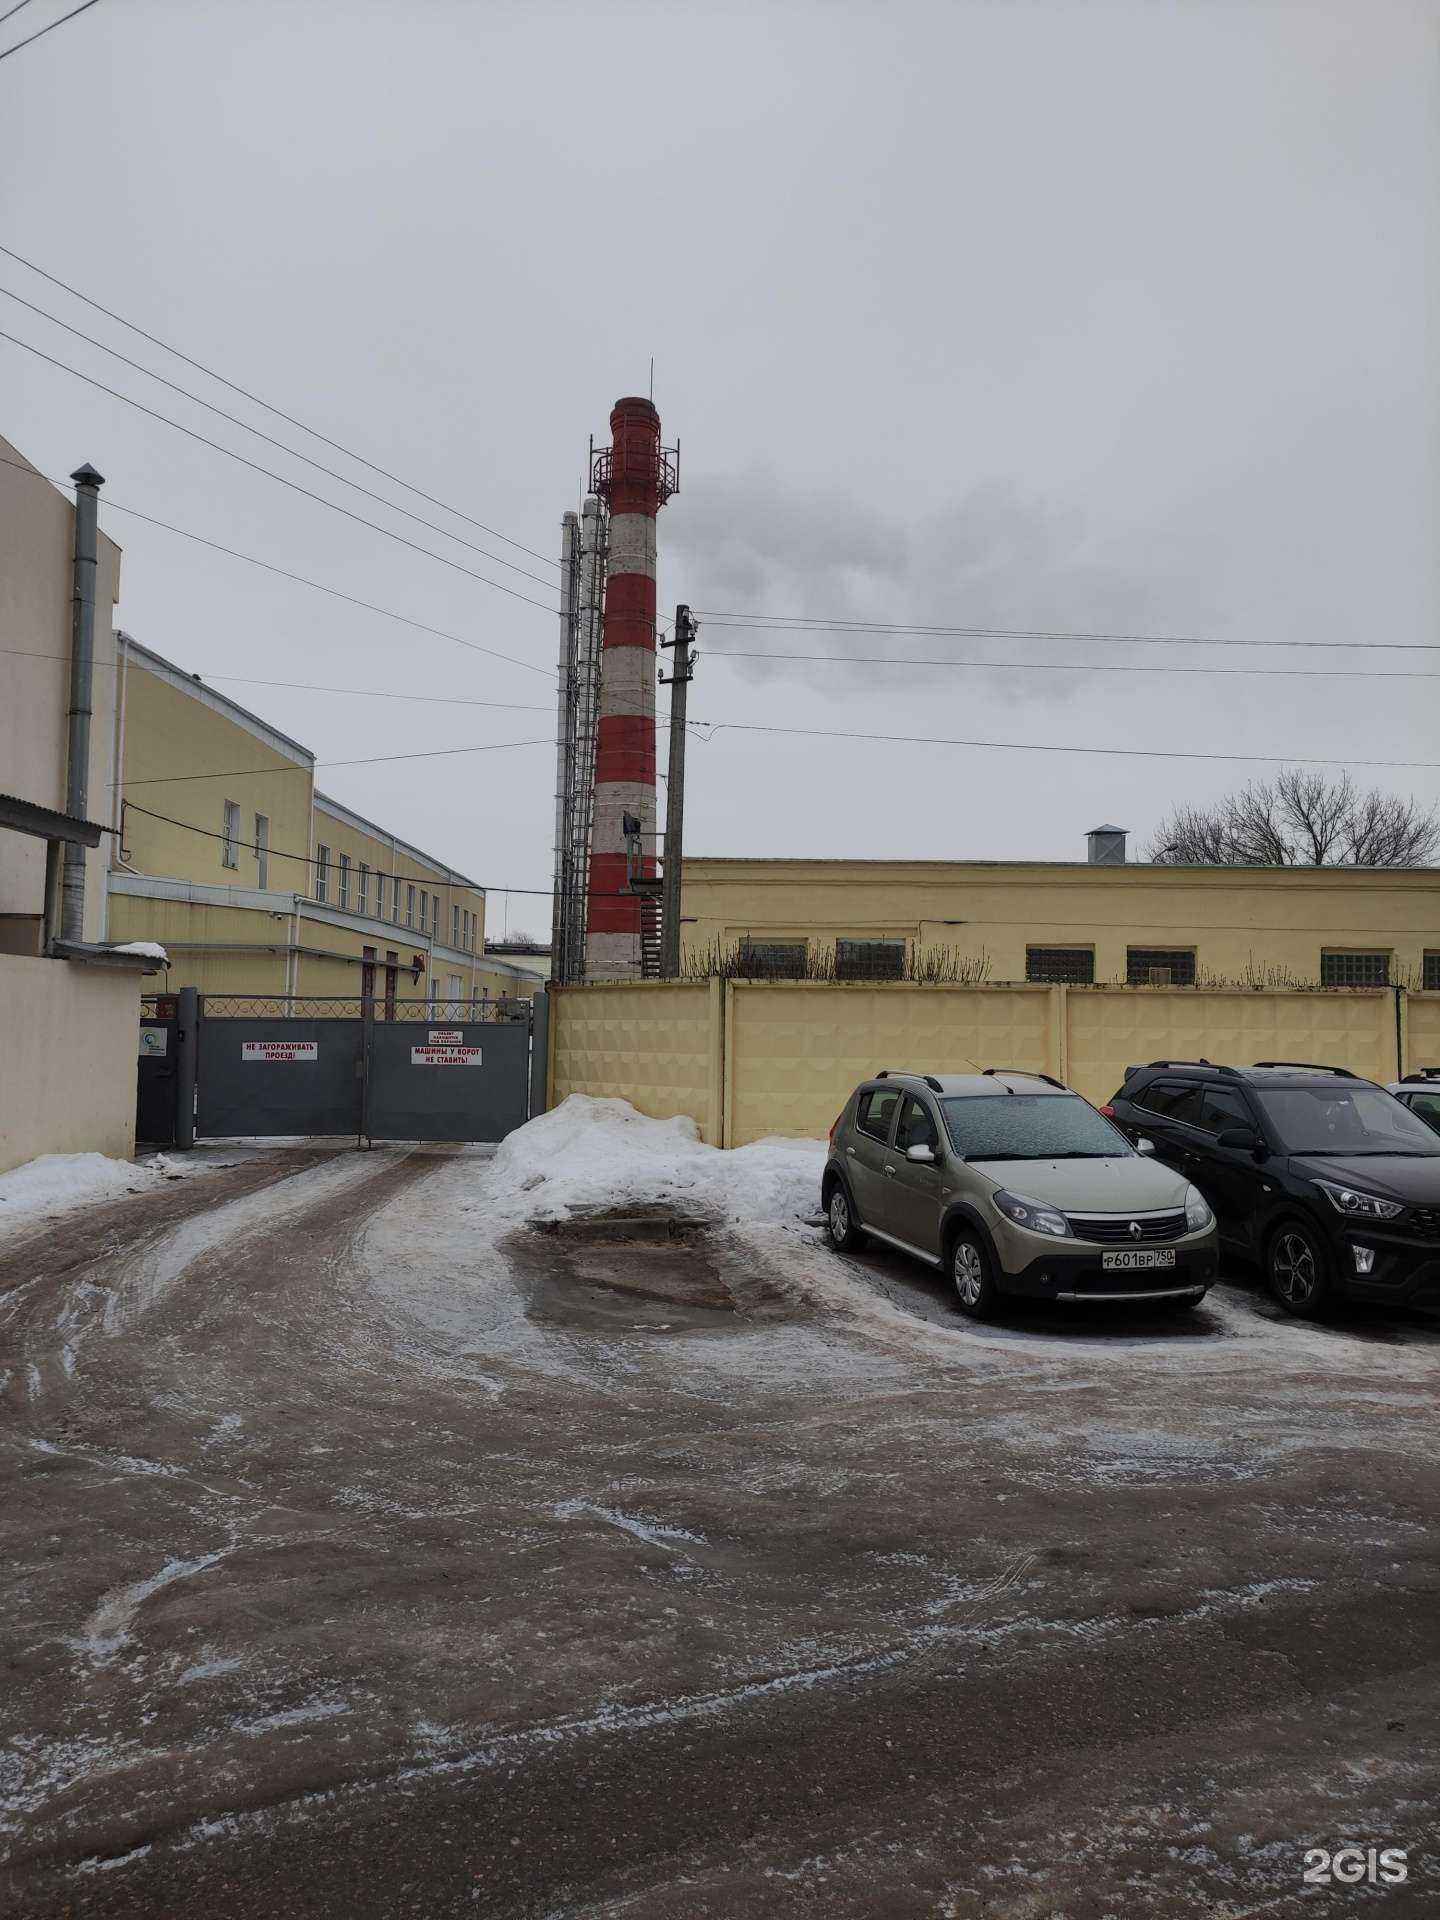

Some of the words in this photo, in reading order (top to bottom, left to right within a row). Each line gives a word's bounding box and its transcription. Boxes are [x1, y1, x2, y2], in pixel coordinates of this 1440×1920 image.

[246, 1043, 256, 1051] НЕ
[258, 1043, 314, 1051] ЗАГОРАЖИВАТЬ
[414, 1047, 448, 1055] МАШИНЫ
[457, 1048, 480, 1056] ВОРОТ
[265, 1051, 296, 1060] ПРОЕЗД!
